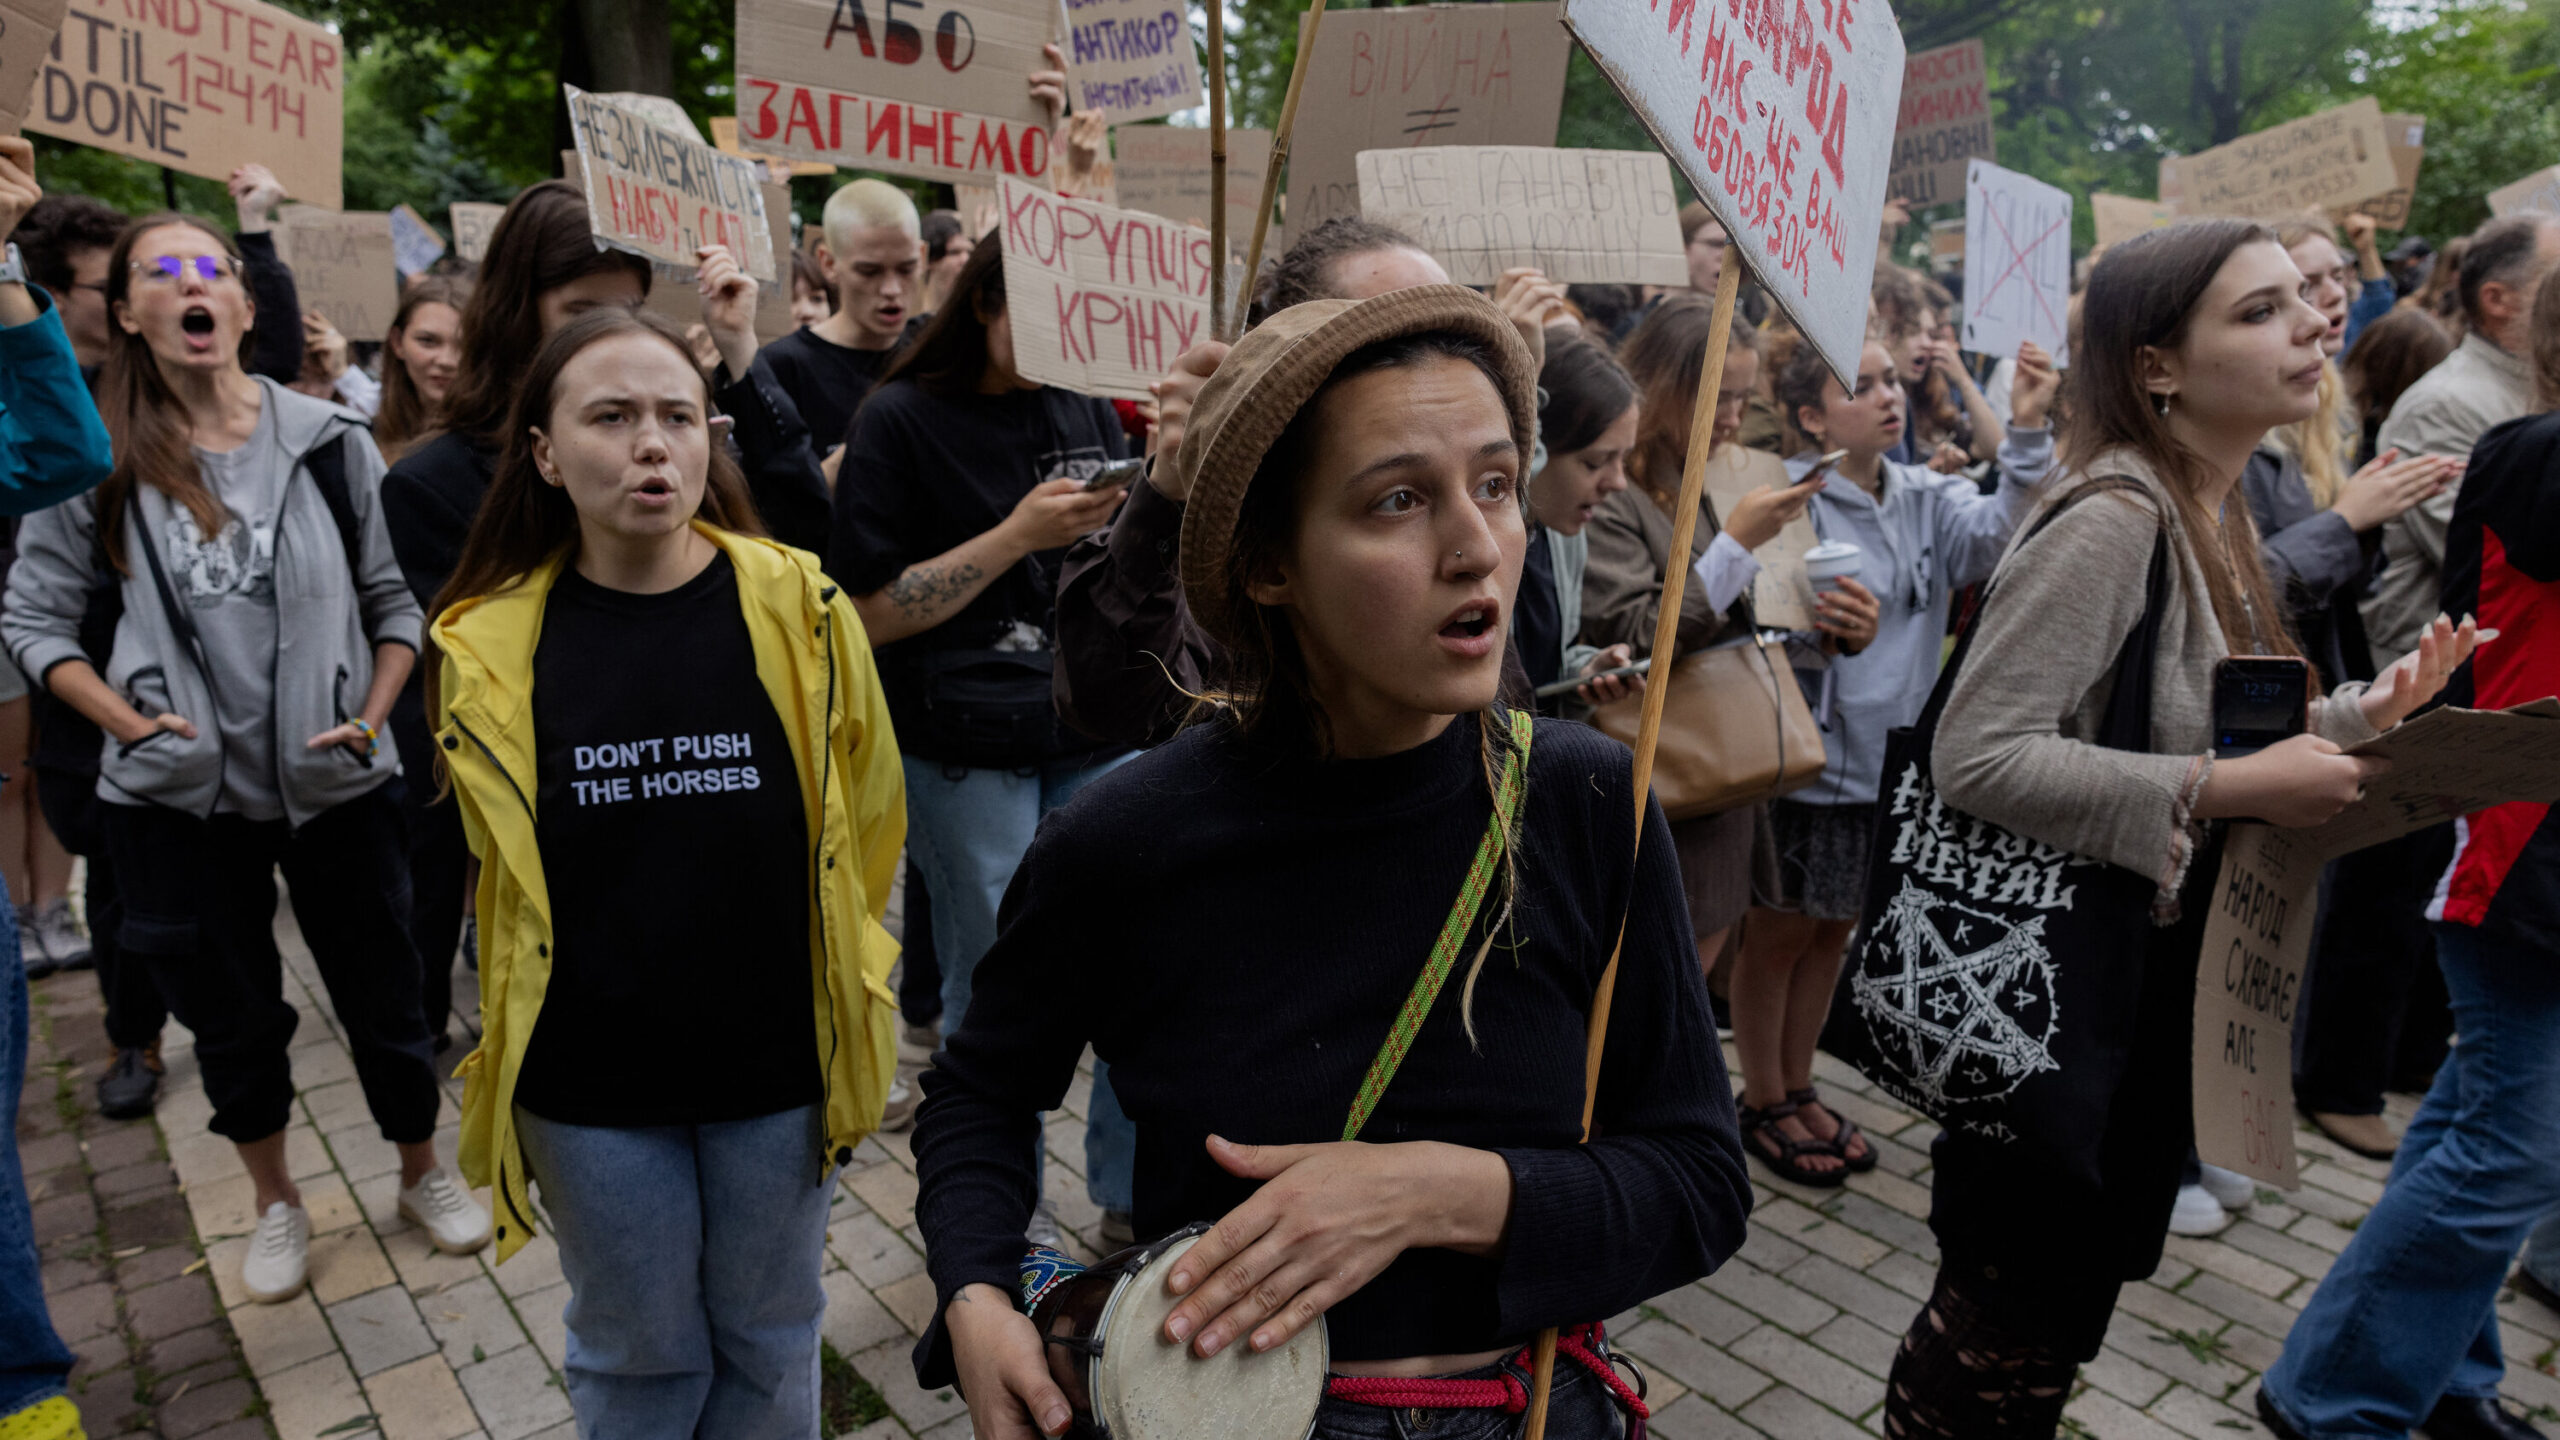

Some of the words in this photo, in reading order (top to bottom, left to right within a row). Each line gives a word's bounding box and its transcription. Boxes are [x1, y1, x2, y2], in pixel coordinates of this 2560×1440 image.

[823, 0, 976, 74] АБО
[1072, 10, 1180, 65] АНТИКОР
[1349, 13, 1513, 107] ВІЙНА
[1903, 46, 1977, 89] НОСТІ
[44, 65, 188, 159] DONE
[167, 51, 305, 139] 12414
[742, 77, 1050, 179] ЗАГИНЕМО
[1701, 4, 1754, 125] НАС
[1805, 168, 1848, 273] ВАШ
[1890, 121, 1990, 174] АНОВНІ
[606, 175, 680, 253] НАБУ
[1374, 152, 1451, 208] НЕ
[2243, 681, 2282, 698] 12:57
[571, 778, 633, 806] THE
[641, 766, 761, 799] HORSES
[574, 738, 664, 771] DON'T
[672, 732, 753, 762] PUSH
[2223, 861, 2289, 949] НАРОД
[2224, 936, 2297, 1024] СХАВАЄ
[2223, 1019, 2257, 1075] АЛЕ
